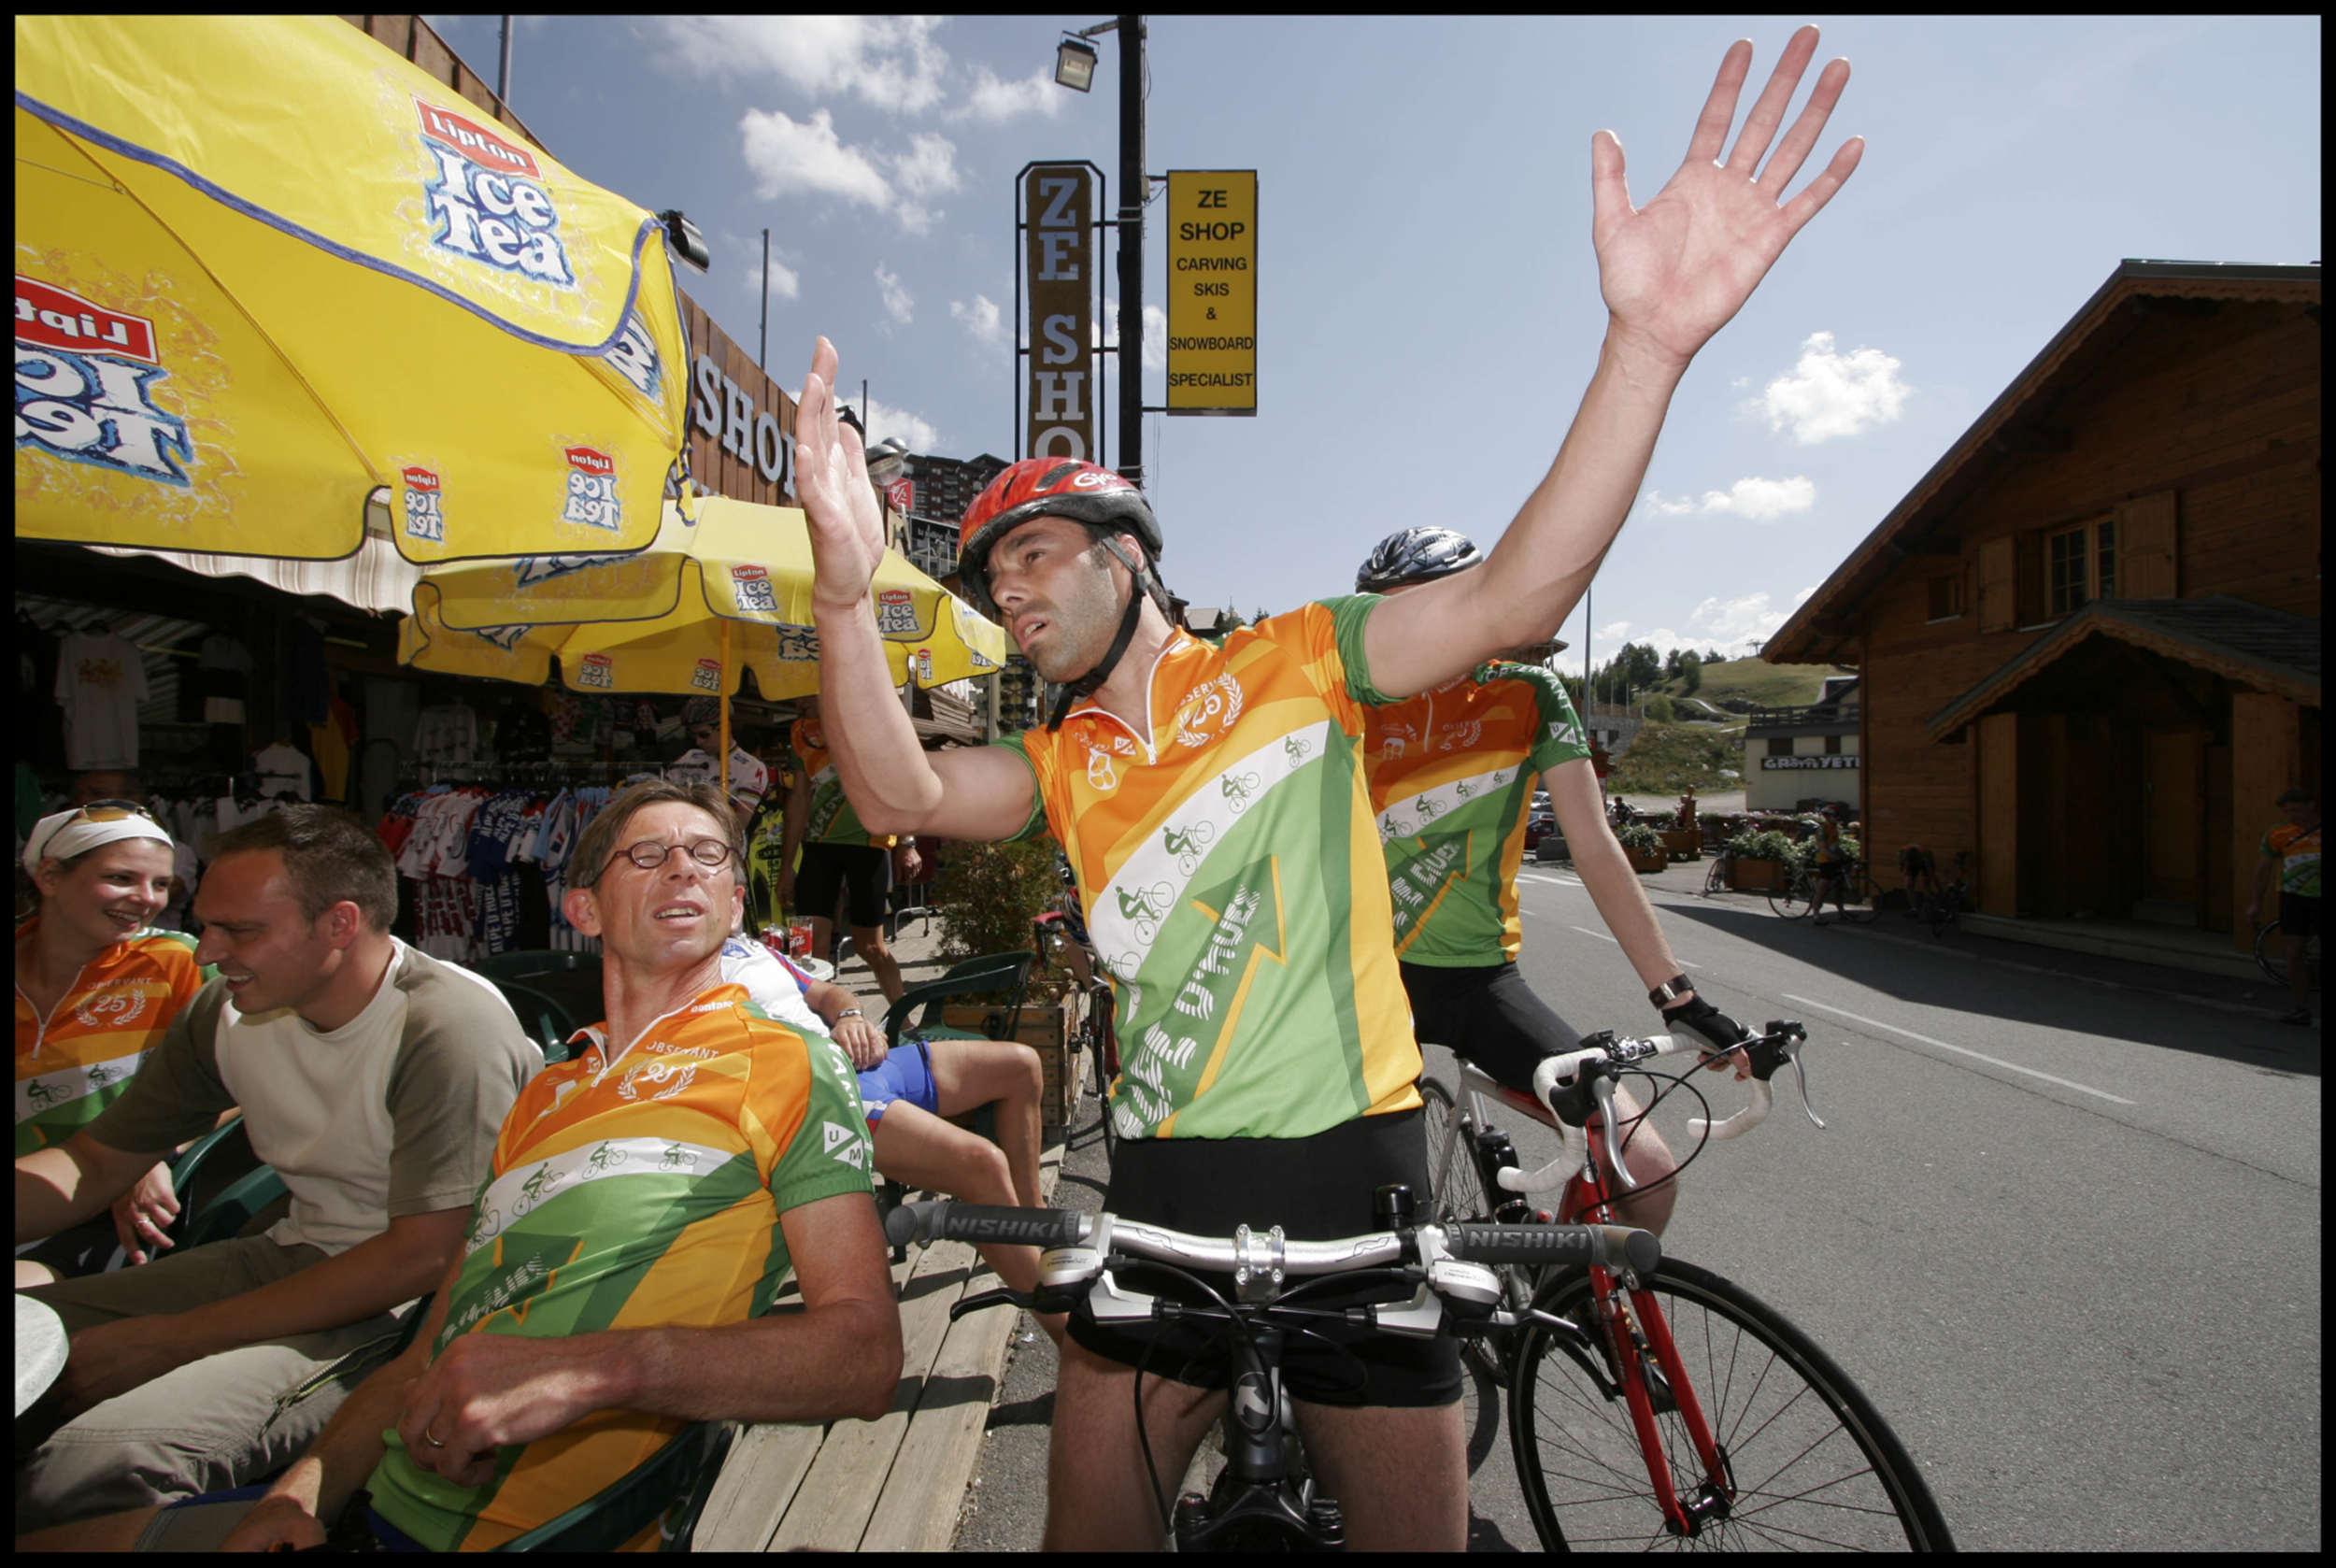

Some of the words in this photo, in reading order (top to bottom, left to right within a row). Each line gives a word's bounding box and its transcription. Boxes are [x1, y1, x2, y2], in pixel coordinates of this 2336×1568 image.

[429, 110, 529, 168] Lipton
[431, 146, 554, 228] Ice
[1197, 190, 1228, 208] ZE
[431, 192, 572, 282] Tea
[1038, 178, 1079, 280] ZE
[1179, 221, 1245, 241] SHOP
[1175, 257, 1247, 271] CARVING
[1193, 282, 1230, 296] SKIS
[1205, 306, 1218, 321] &
[1169, 336, 1254, 350] SNOWBOARD
[1168, 373, 1253, 387] SPECIALIST
[1074, 472, 1118, 487] Giro
[734, 567, 764, 578] Lipton
[734, 579, 772, 596] Ice
[736, 593, 777, 611] Tea
[881, 592, 908, 602] Lipton
[879, 603, 914, 620] Ice
[878, 616, 919, 633] Tea
[93, 992, 128, 1013] 25
[829, 1129, 839, 1143] U
[848, 1147, 862, 1162] M
[947, 1217, 1062, 1239] NISHIKI
[1468, 1230, 1588, 1249] NISHIKI
